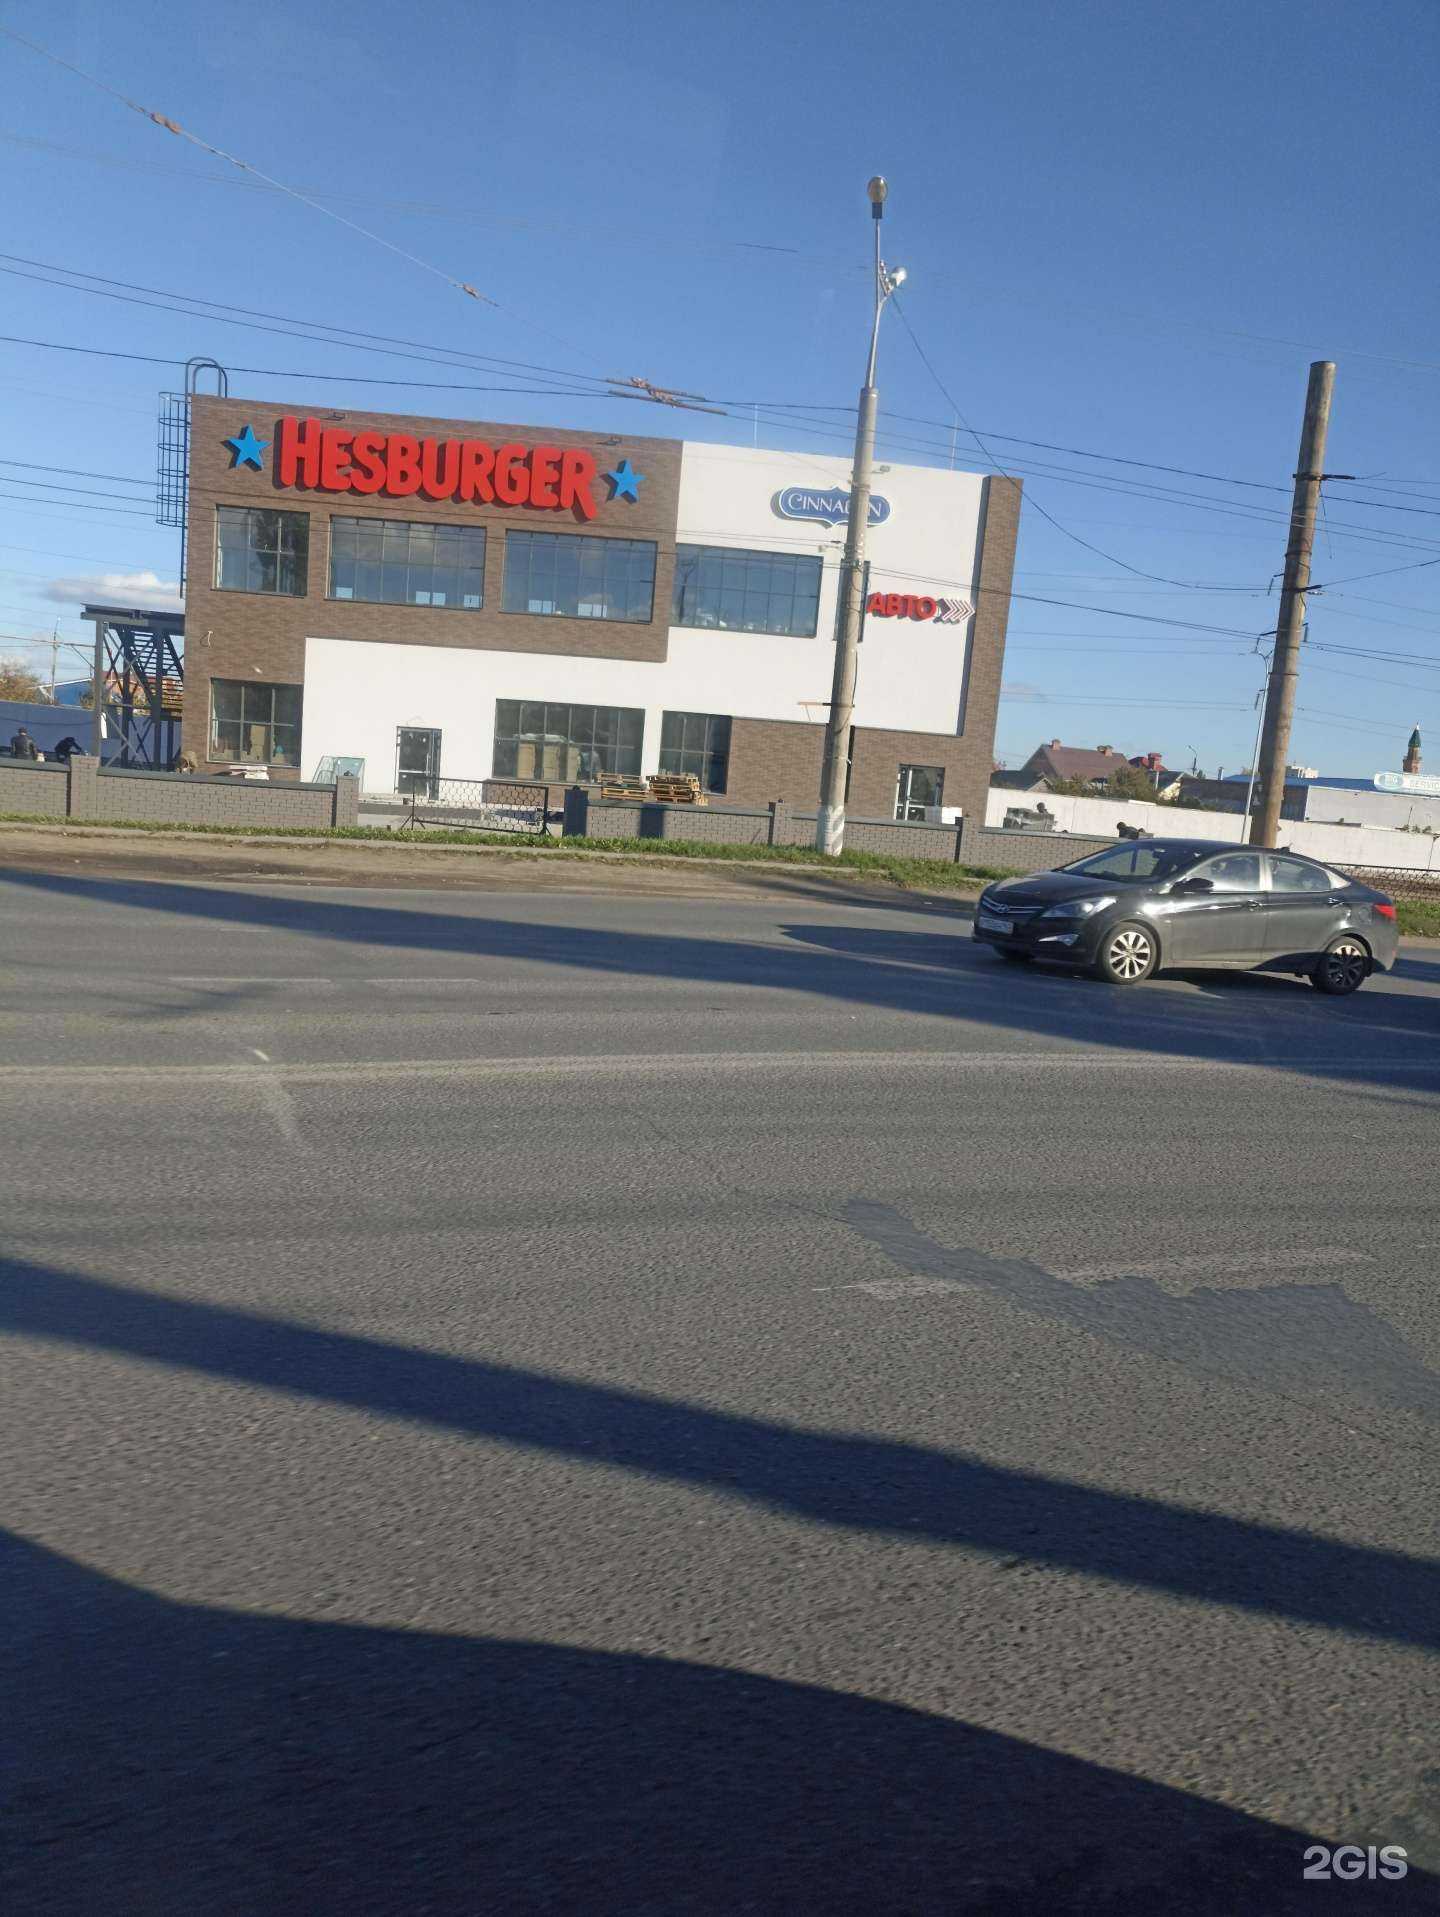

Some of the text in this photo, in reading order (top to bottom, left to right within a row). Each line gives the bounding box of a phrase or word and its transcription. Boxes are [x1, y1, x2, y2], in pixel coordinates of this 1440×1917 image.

[278, 416, 598, 520] HESBURGER
[788, 494, 881, 518] CINNAN
[866, 592, 937, 620] АВТО
